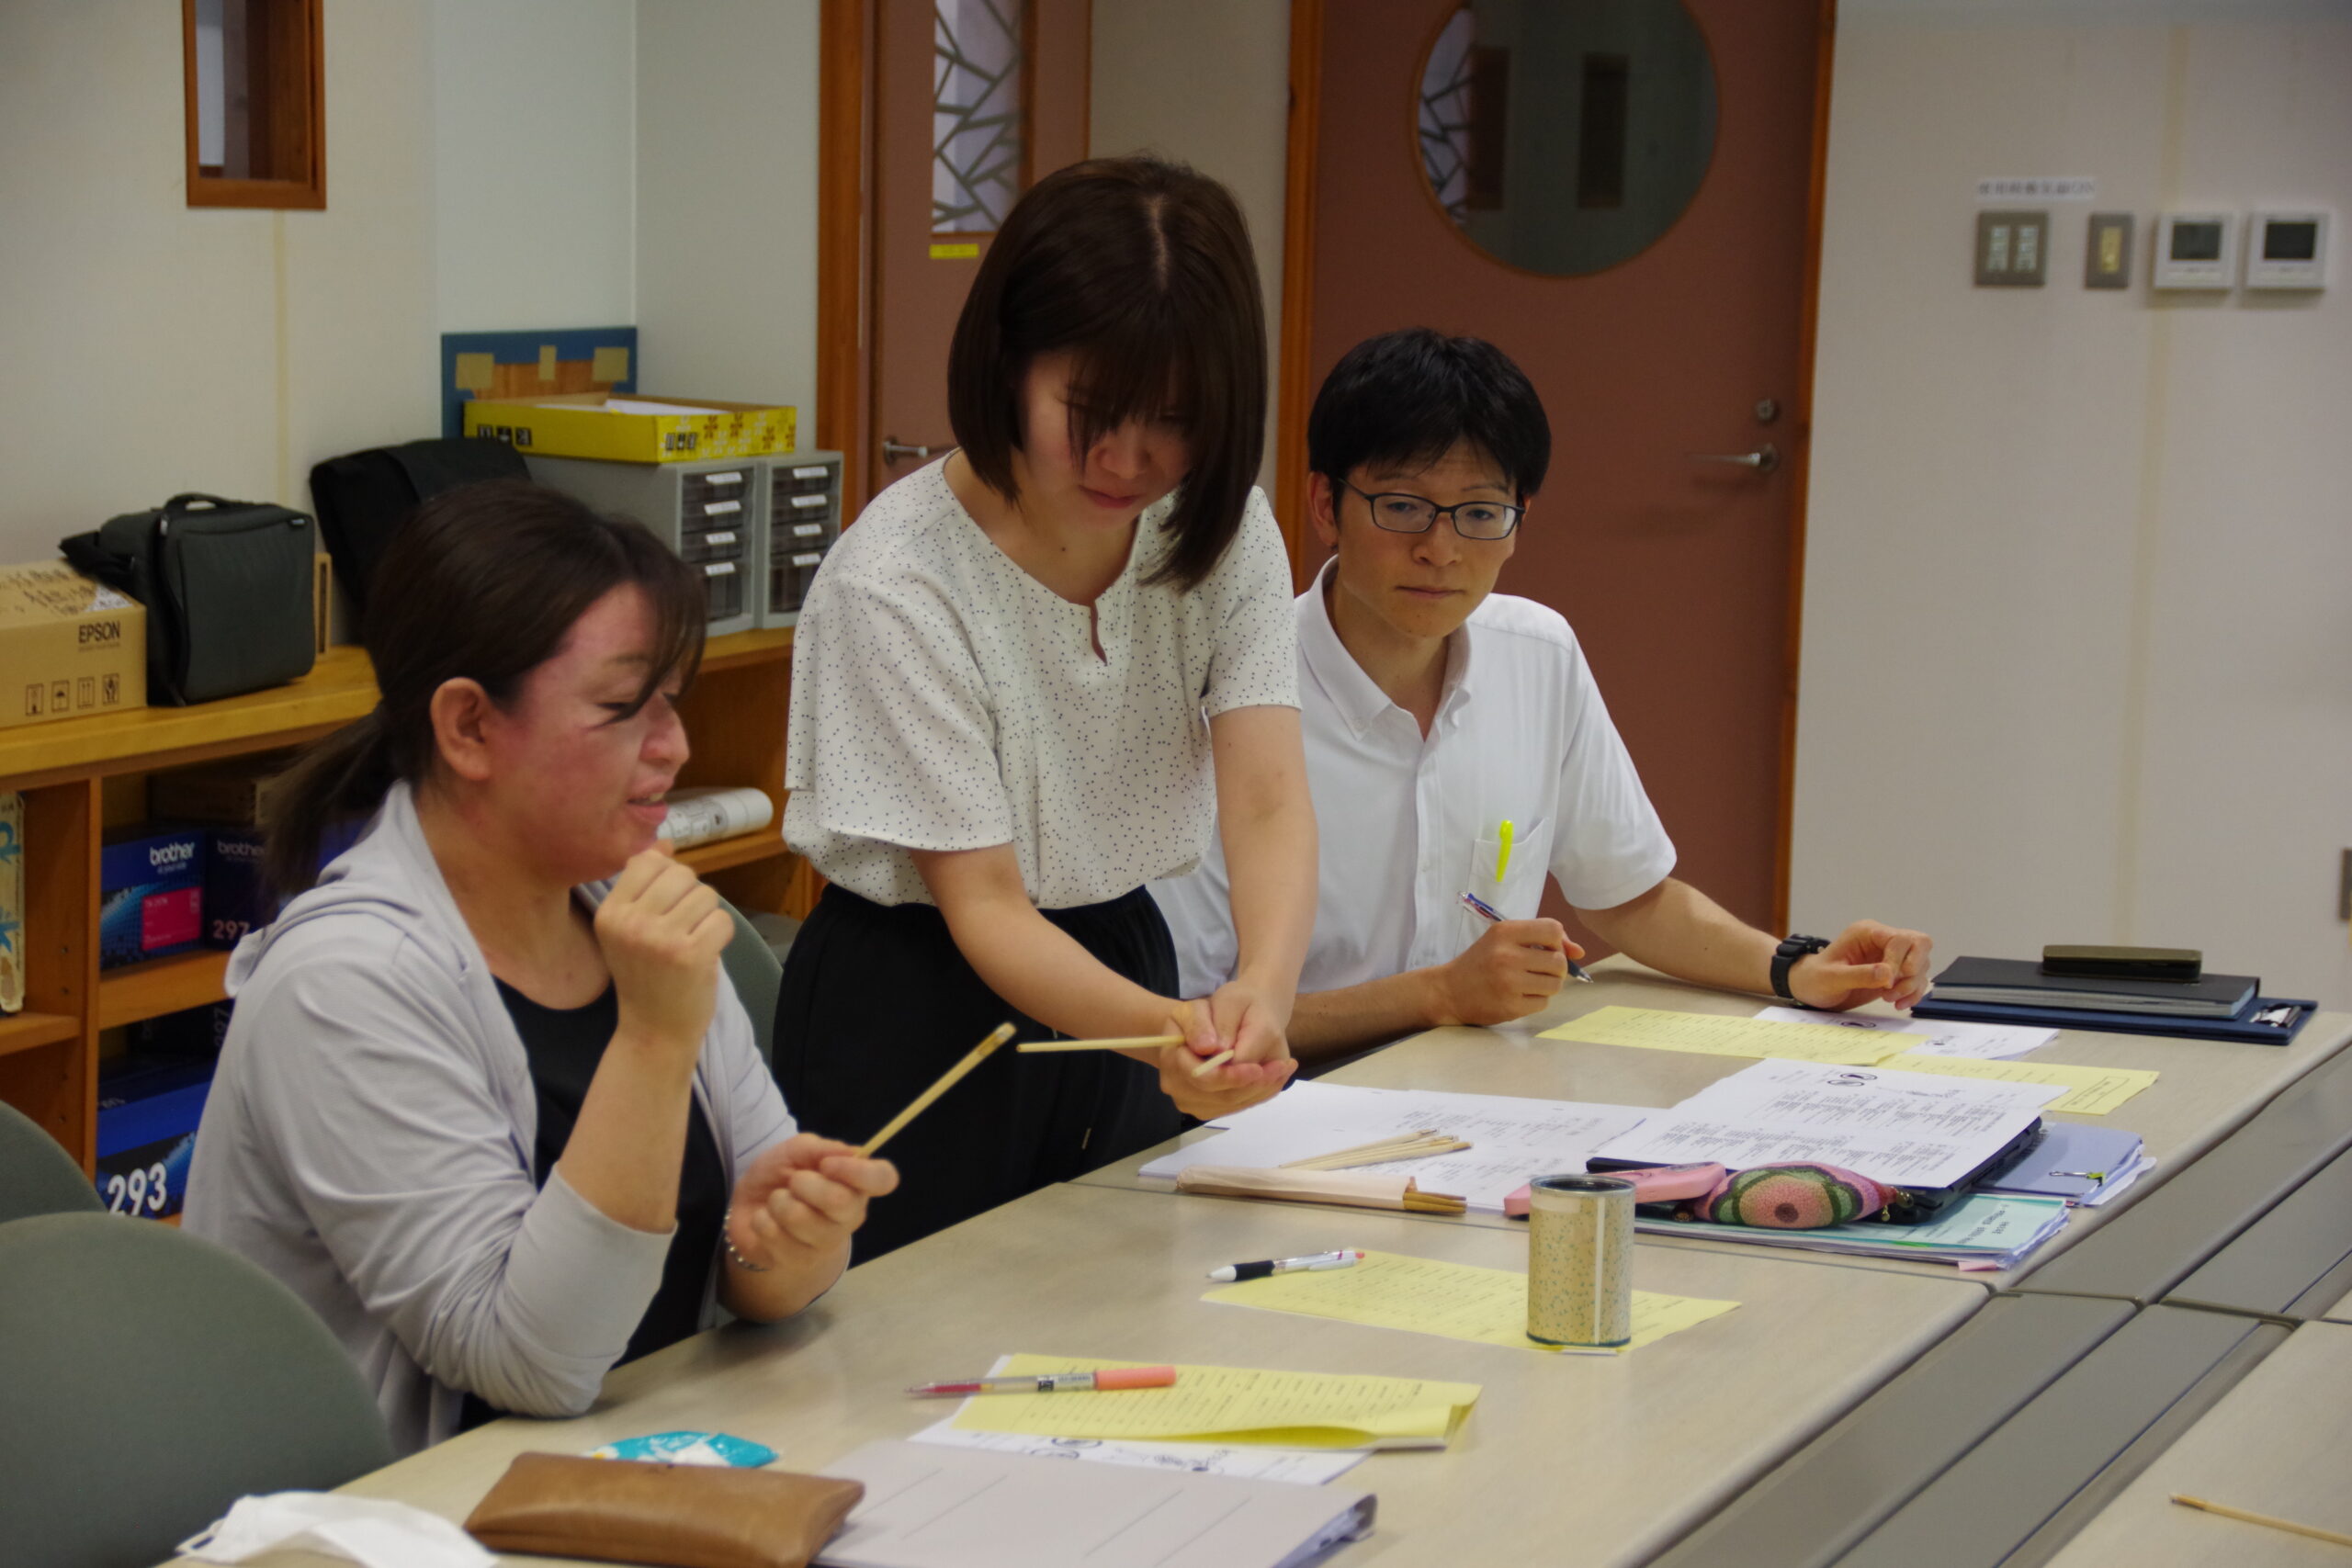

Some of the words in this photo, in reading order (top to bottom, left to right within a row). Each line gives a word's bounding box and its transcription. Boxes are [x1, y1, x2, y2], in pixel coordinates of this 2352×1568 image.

[78, 621, 120, 643] EPSON
[150, 841, 195, 866] brother
[212, 919, 251, 940] 297
[107, 1162, 167, 1217] 293
